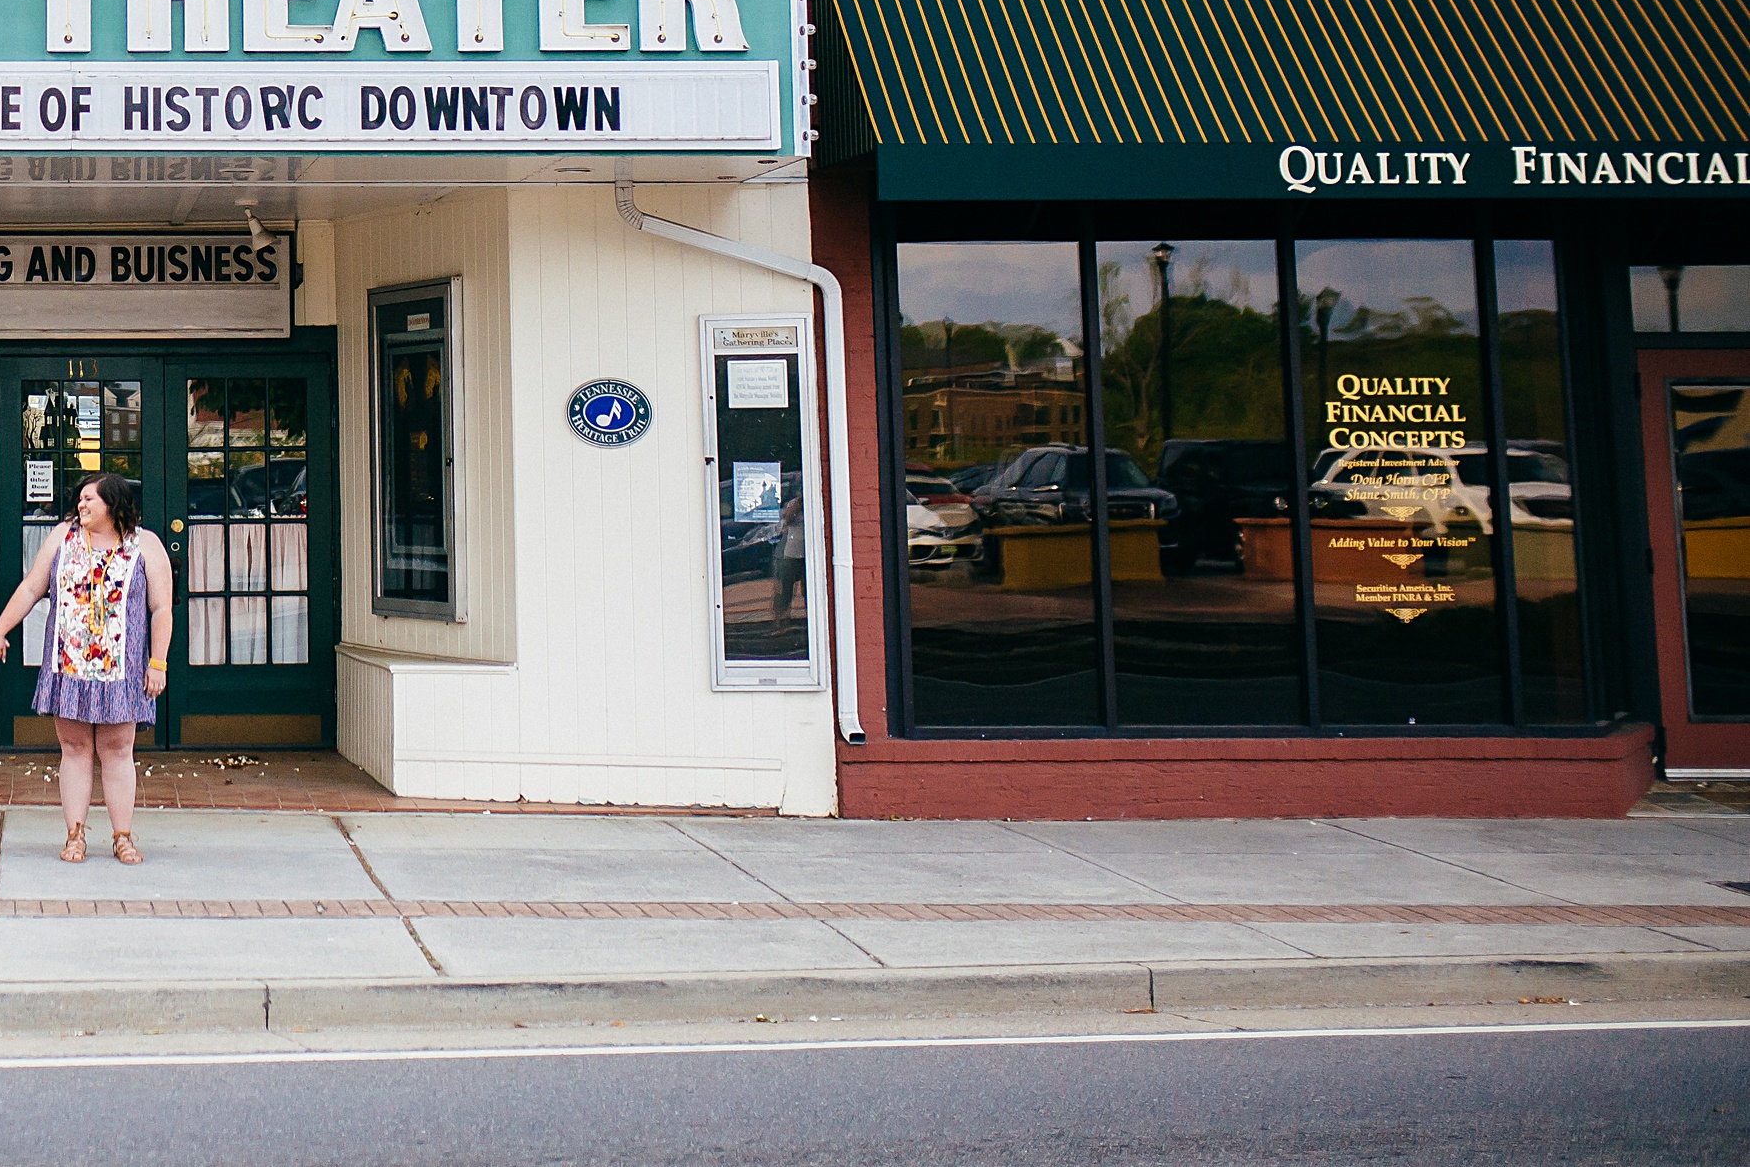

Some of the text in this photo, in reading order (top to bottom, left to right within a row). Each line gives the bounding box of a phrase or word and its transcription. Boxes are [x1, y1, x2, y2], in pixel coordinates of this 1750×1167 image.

[39, 86, 92, 131] OF
[361, 85, 622, 132] DOWNTOWN
[26, 245, 96, 282] AND
[111, 245, 278, 282] BUISNESS
[732, 330, 779, 341] Maryville's
[69, 359, 98, 378] 113
[577, 383, 640, 404] TENNESSEE
[572, 414, 648, 443] HERITAGE TRAIL
[1338, 458, 1380, 469] Registered
[1381, 458, 1426, 468] Investment
[1351, 474, 1383, 489] Doug
[1344, 488, 1380, 501] Shane
[1329, 538, 1365, 550] Adding
[1367, 538, 1396, 548] Value
[1398, 538, 1408, 548] to
[1411, 538, 1434, 548] Your
[1356, 585, 1454, 594] Securities America, Inc.
[1356, 594, 1456, 602] Member FINRA & SIPC
